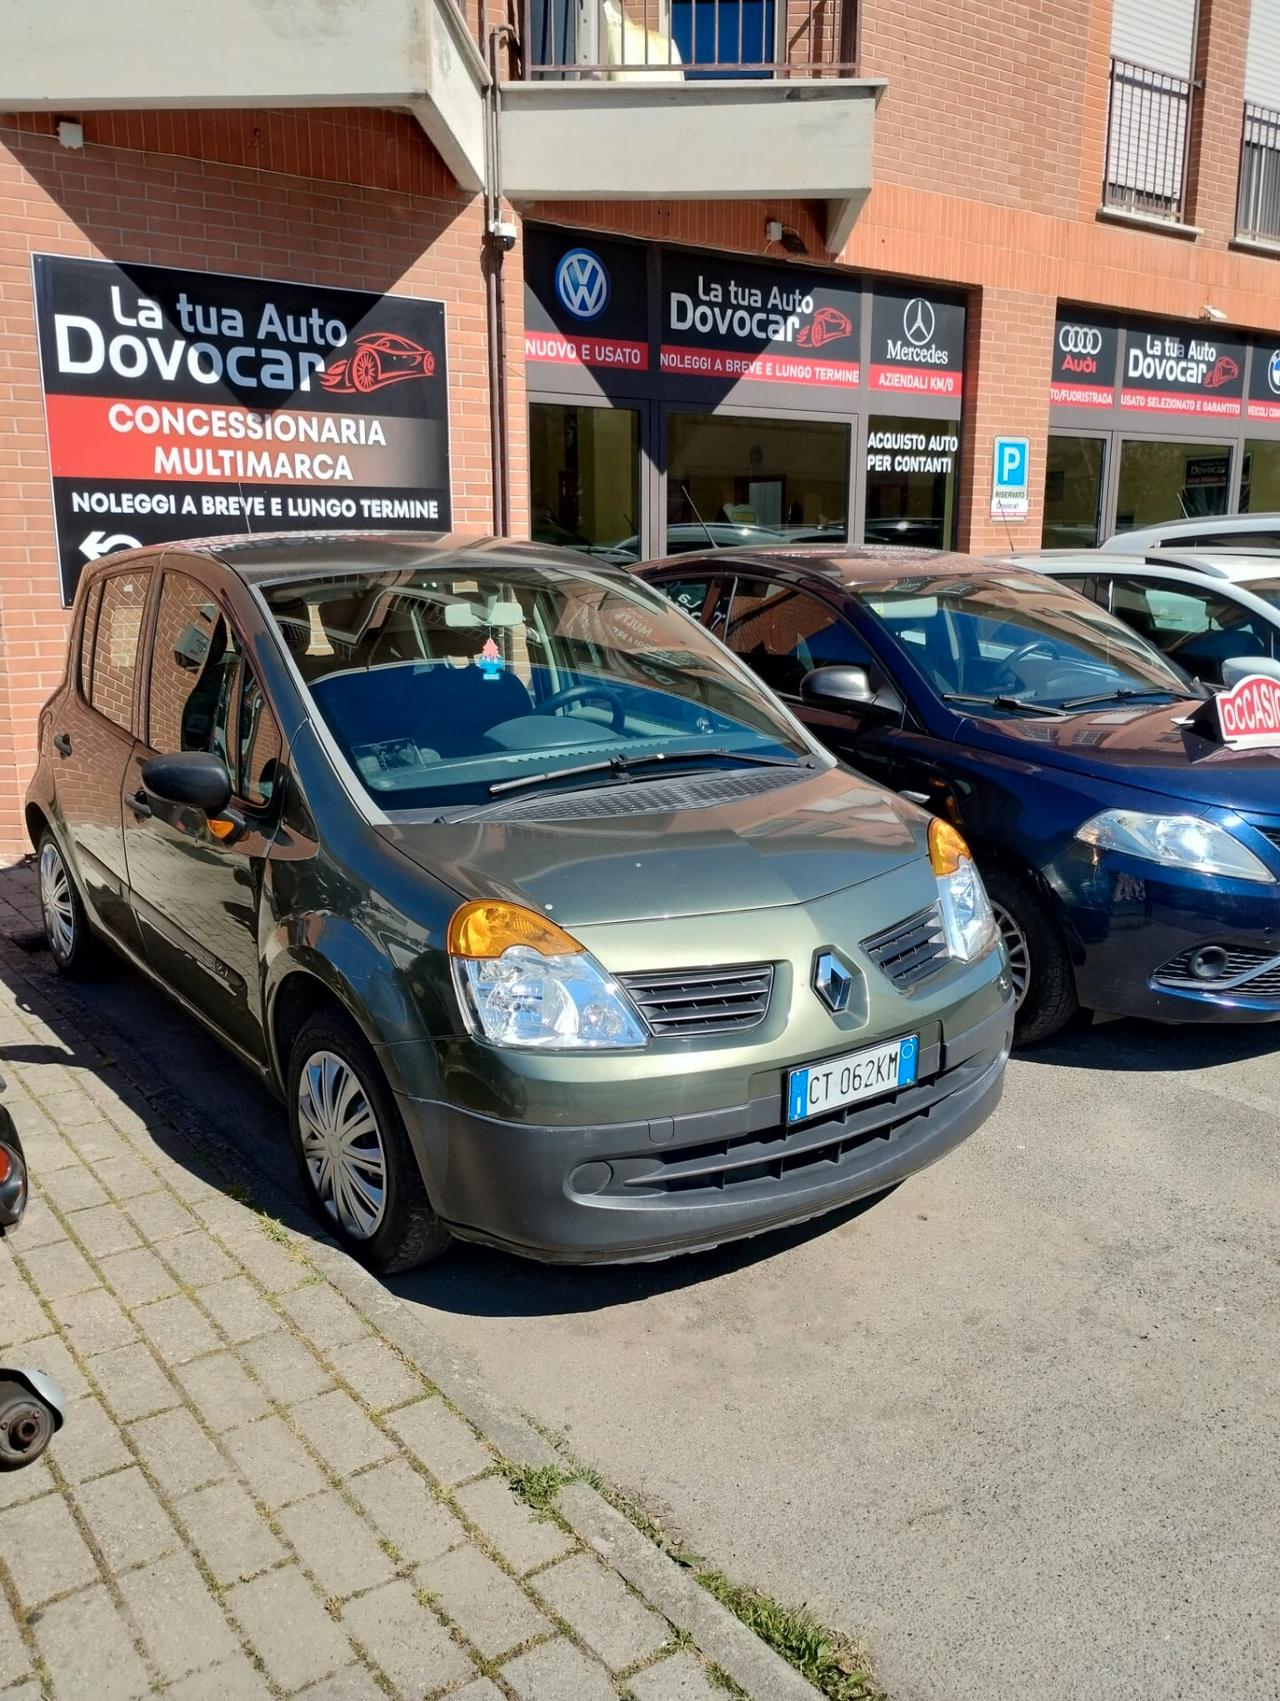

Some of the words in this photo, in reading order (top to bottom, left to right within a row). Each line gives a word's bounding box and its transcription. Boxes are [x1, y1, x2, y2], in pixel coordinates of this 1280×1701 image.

[698, 275, 722, 303] La
[728, 281, 762, 306] tua
[767, 286, 814, 314] Auto
[110, 285, 163, 329] La
[176, 294, 244, 338] tua
[257, 303, 348, 347] Auto
[670, 293, 800, 342] Dovocar
[54, 313, 325, 391] Dovocar
[525, 341, 577, 361] NUOVO
[581, 344, 590, 361] E
[595, 345, 641, 364] USATO
[887, 340, 948, 365] Mercedes
[1061, 354, 1097, 373] Audi
[1146, 335, 1161, 355] La
[1164, 336, 1185, 358] tua
[1188, 340, 1216, 362] Auto
[660, 353, 711, 370] NOLEGGI
[714, 357, 723, 371] A
[725, 358, 763, 376] BREVE
[765, 362, 773, 377] E
[775, 363, 812, 380] LUNGO
[813, 366, 860, 383] TERMINE
[1128, 348, 1206, 383] Dovocar
[878, 374, 928, 390] AZIENDALI
[1120, 394, 1145, 407] USATO
[1147, 397, 1195, 411] SELEZIONATO
[1196, 401, 1201, 411] E
[1202, 402, 1240, 414] GARANTITO
[108, 403, 387, 446] CONCESSIONARIA
[867, 432, 926, 452] ACQUISTO
[928, 434, 958, 453] AUTO
[154, 446, 354, 480] MULTIMARCA
[867, 455, 891, 472] PER
[894, 455, 951, 474] CONTANTI
[1003, 447, 1020, 481] P
[72, 491, 176, 515] NOLEGGI
[181, 493, 197, 515] A
[202, 494, 265, 517] BREVE
[271, 496, 282, 517] E
[288, 498, 356, 518] LUNGO
[360, 499, 439, 519] TERMINE
[809, 1071, 834, 1105] CT
[840, 1051, 899, 1095] 062KM
